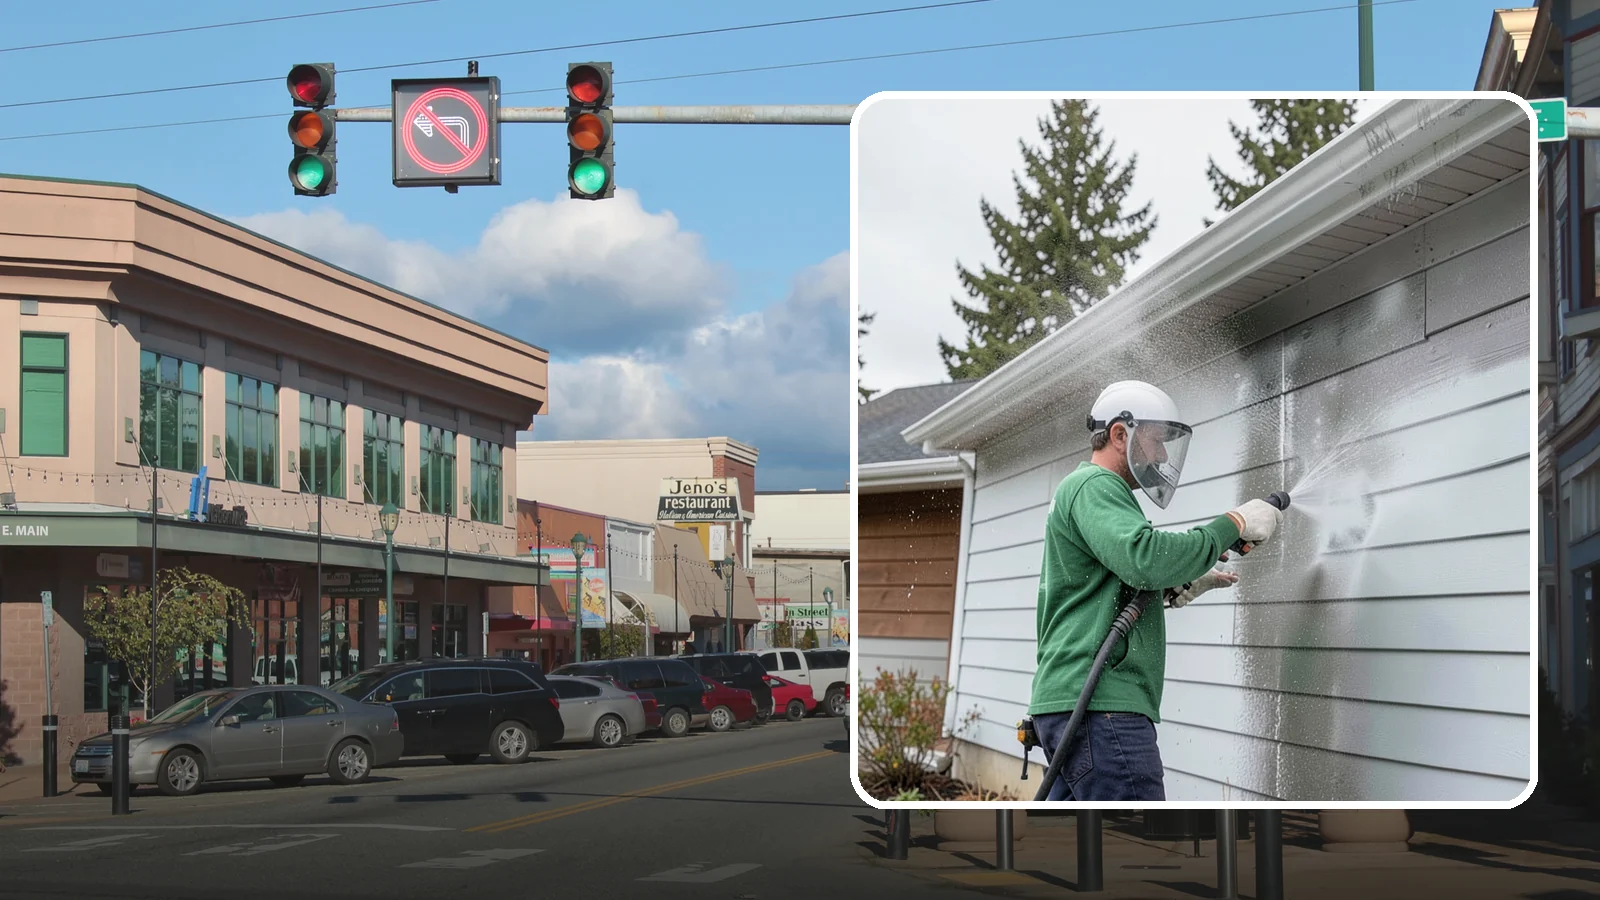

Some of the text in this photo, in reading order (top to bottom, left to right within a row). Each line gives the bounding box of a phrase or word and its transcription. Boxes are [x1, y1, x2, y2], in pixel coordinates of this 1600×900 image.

[669, 480, 728, 494] Jeno's
[665, 496, 731, 509] restaurant
[658, 509, 681, 520] Italian
[686, 509, 715, 519] American
[715, 509, 737, 519] Cuisine
[2, 525, 49, 536] E. MAIN
[797, 607, 828, 616] Street
